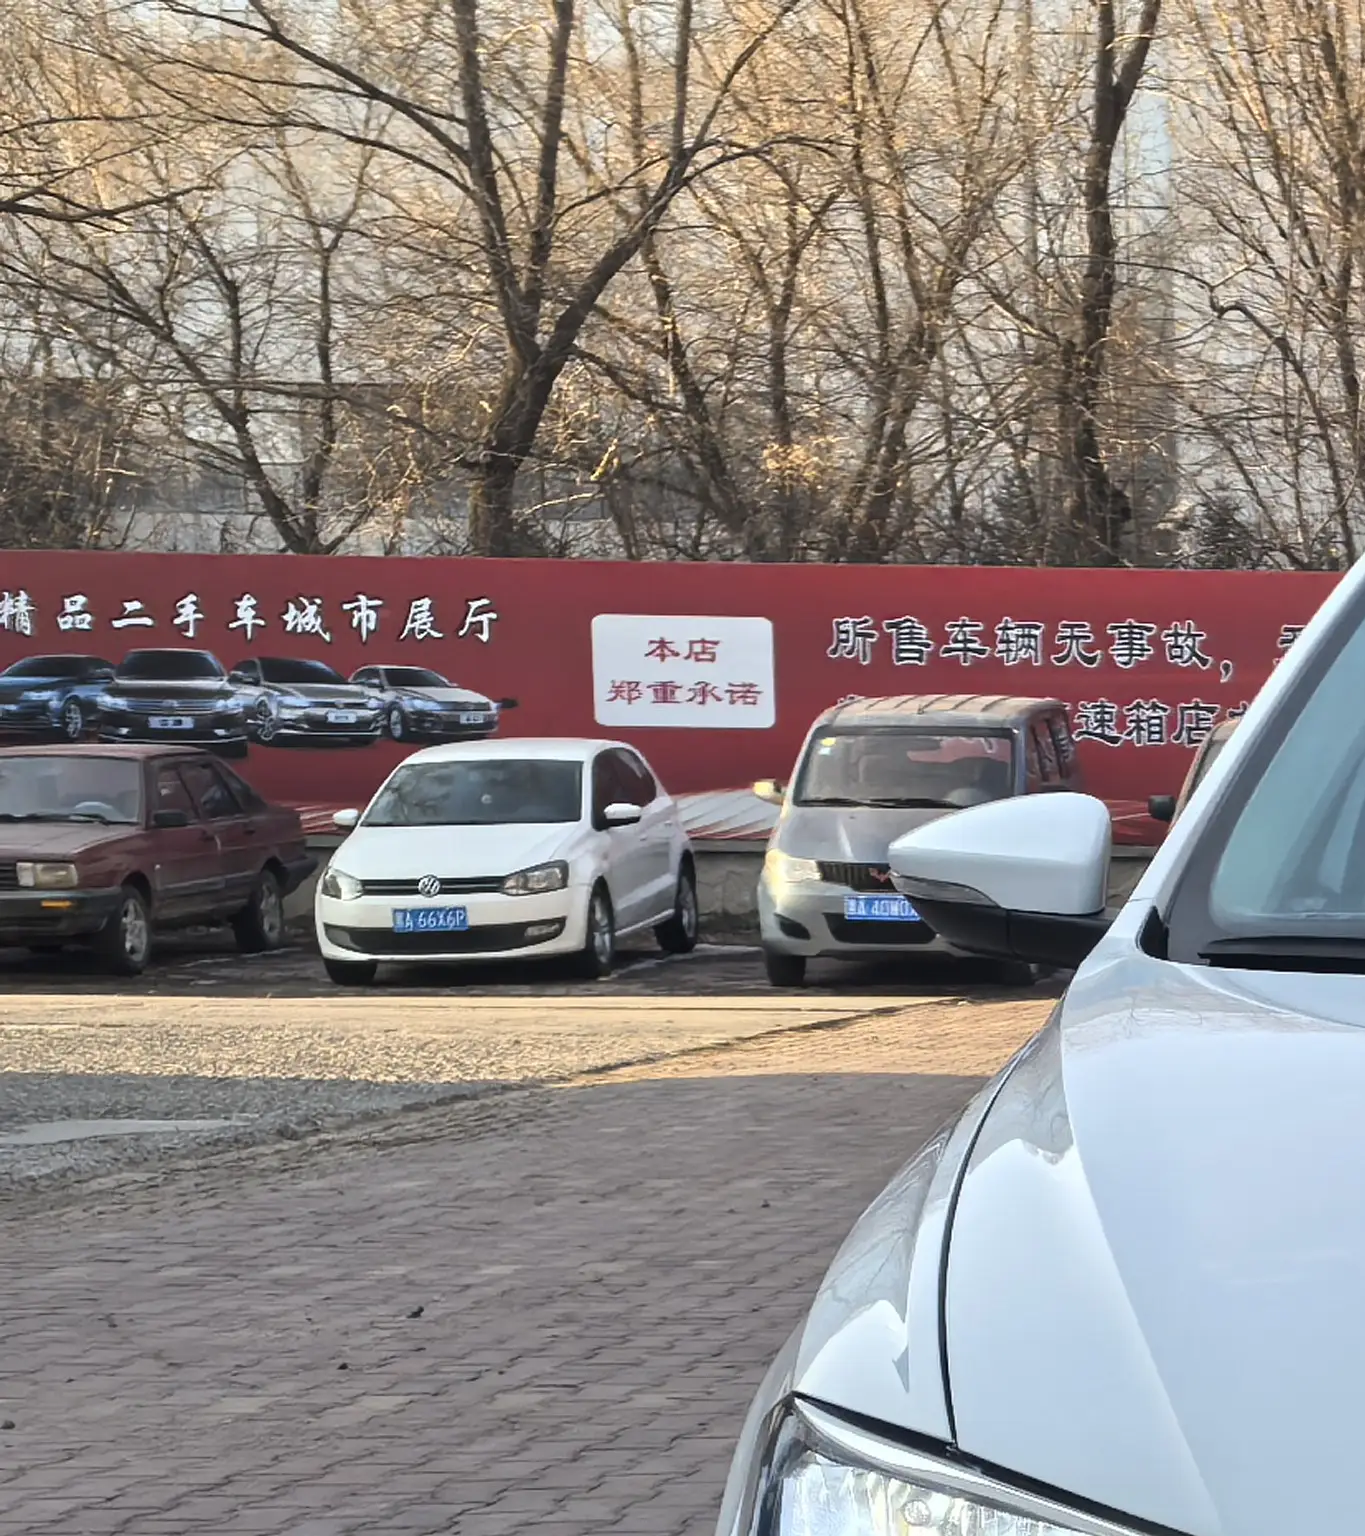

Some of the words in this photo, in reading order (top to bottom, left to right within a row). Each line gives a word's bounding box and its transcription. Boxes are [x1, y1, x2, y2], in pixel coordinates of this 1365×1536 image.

[0, 590, 498, 643] 精品二手车城市展厅
[644, 637, 721, 664] 本店
[827, 616, 1306, 683] 所售车辆无事故，
[605, 679, 765, 706] 郑重承诺
[1063, 697, 1253, 748] 速箱店
